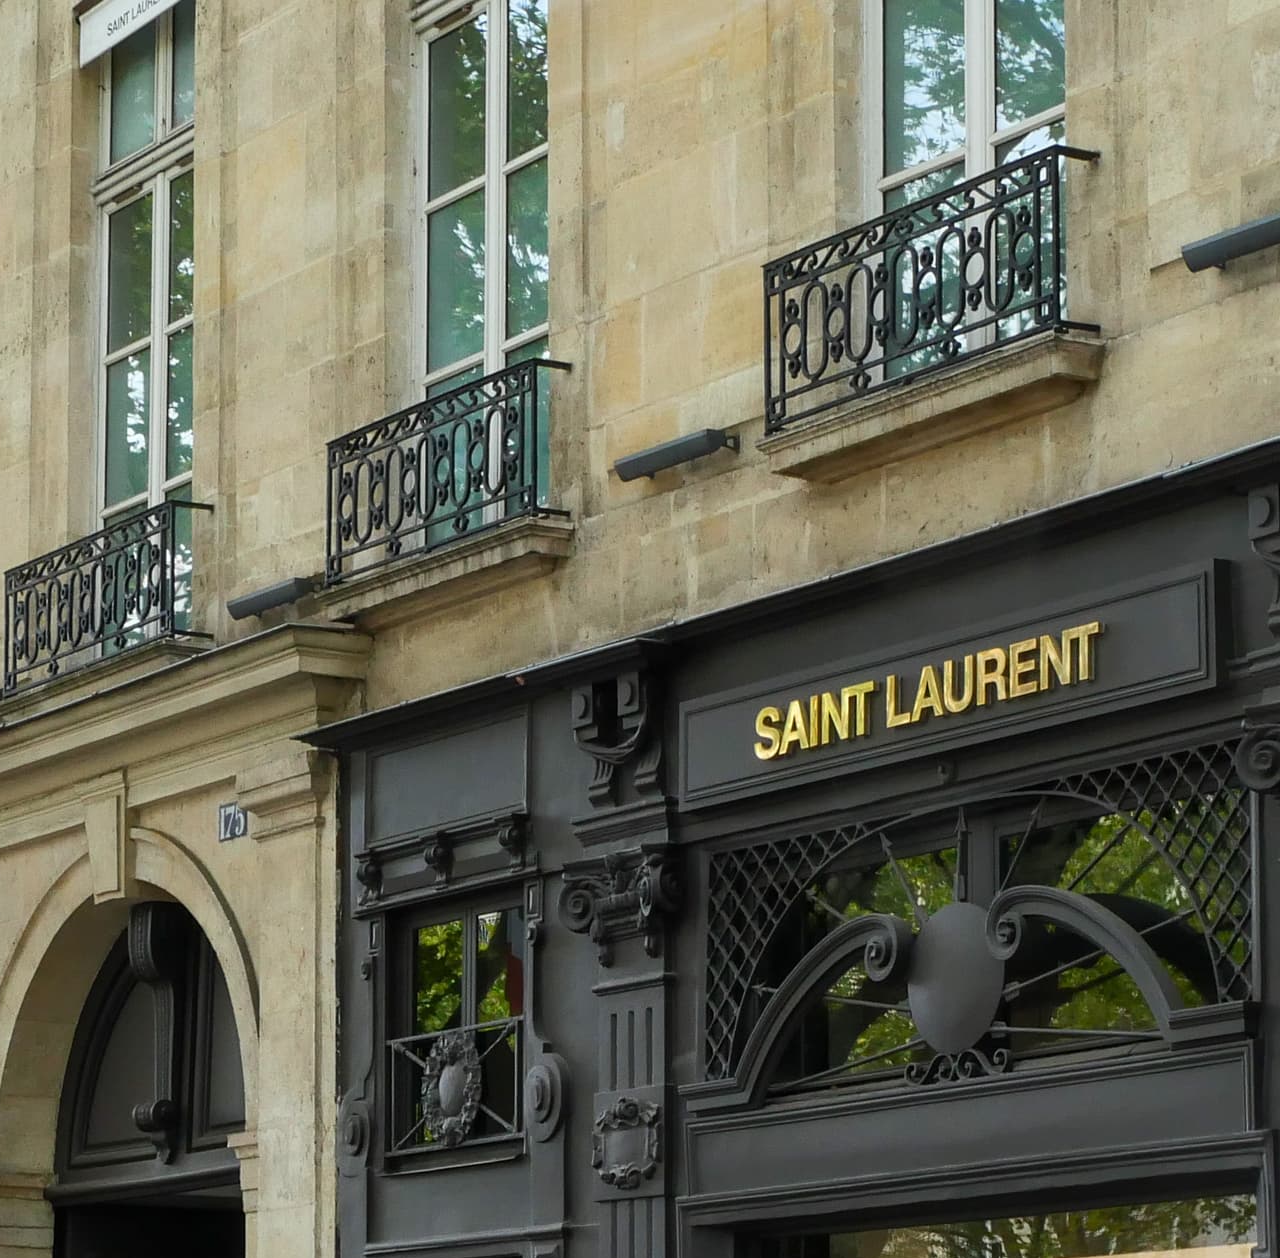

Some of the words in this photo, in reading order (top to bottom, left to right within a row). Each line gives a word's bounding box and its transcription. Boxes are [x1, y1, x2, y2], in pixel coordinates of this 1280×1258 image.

[107, 11, 130, 36] SAINT
[754, 680, 876, 760] SAINT
[886, 621, 1102, 728] LAURENT
[220, 804, 245, 839] 175
